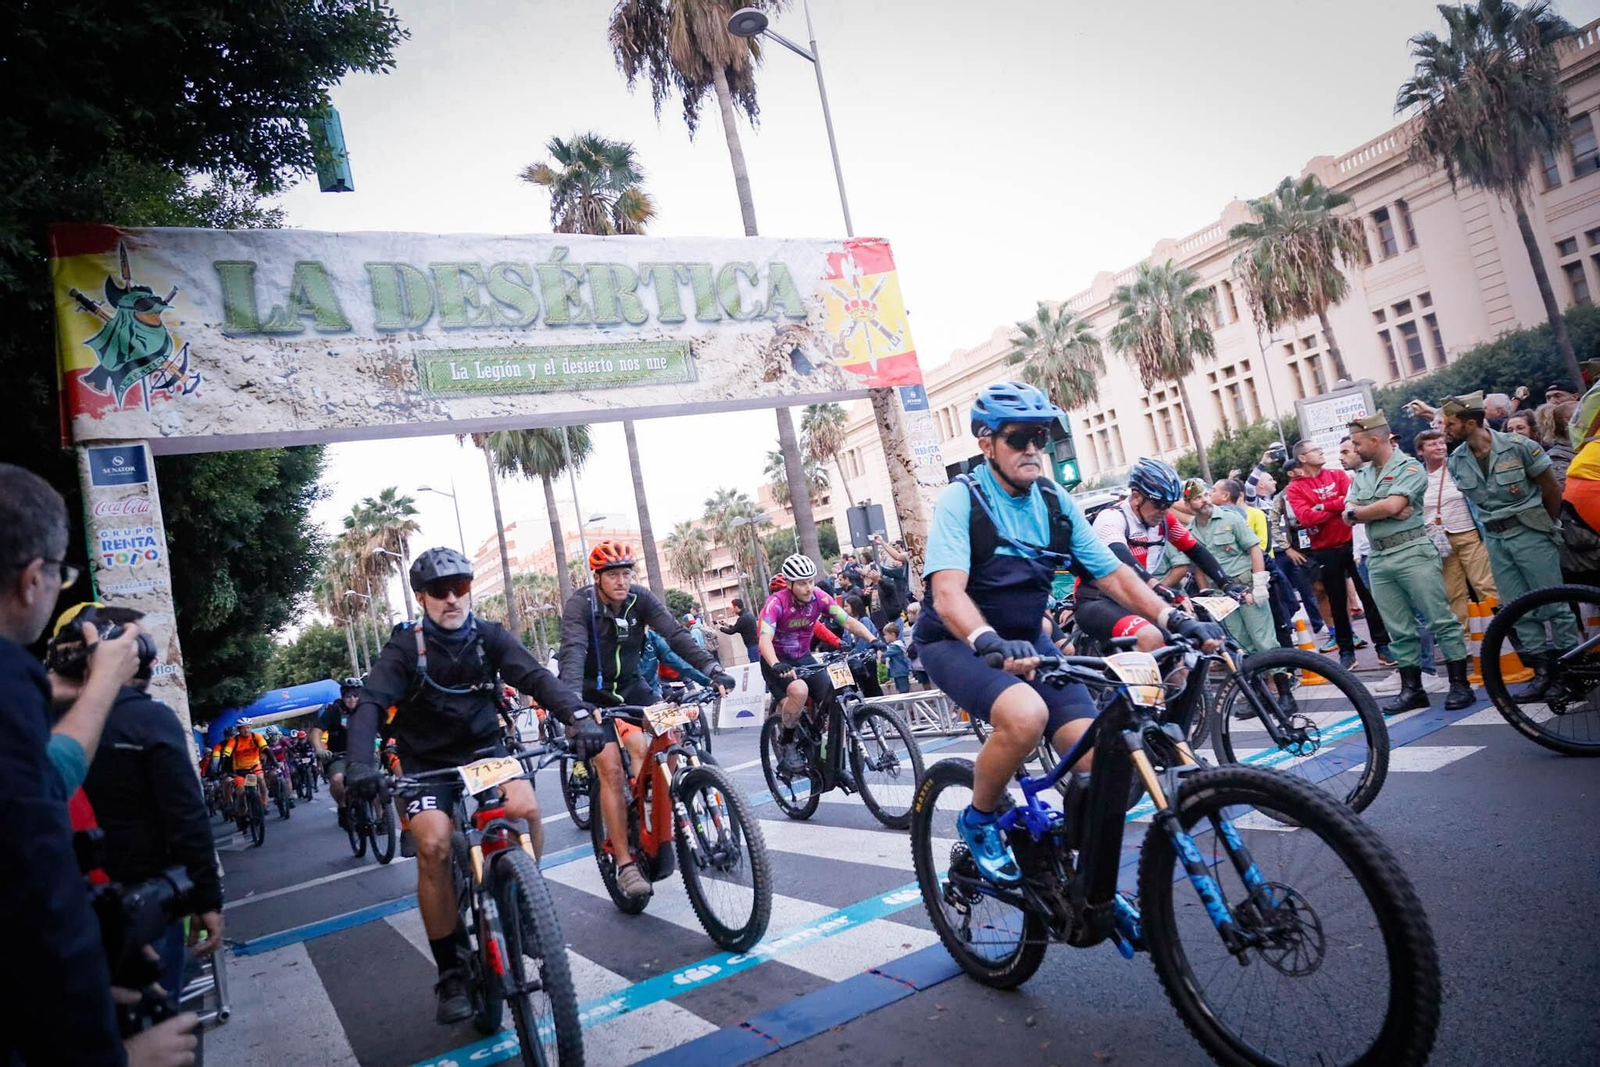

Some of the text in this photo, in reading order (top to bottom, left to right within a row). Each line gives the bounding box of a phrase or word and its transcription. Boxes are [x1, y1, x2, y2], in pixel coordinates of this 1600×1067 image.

[213, 246, 808, 332] LA DESÉRTICA
[450, 356, 668, 382] La Legión y el desierto nos une
[103, 466, 136, 475] SENATOR
[100, 527, 153, 538] GRUPO
[101, 536, 156, 551] RENTA
